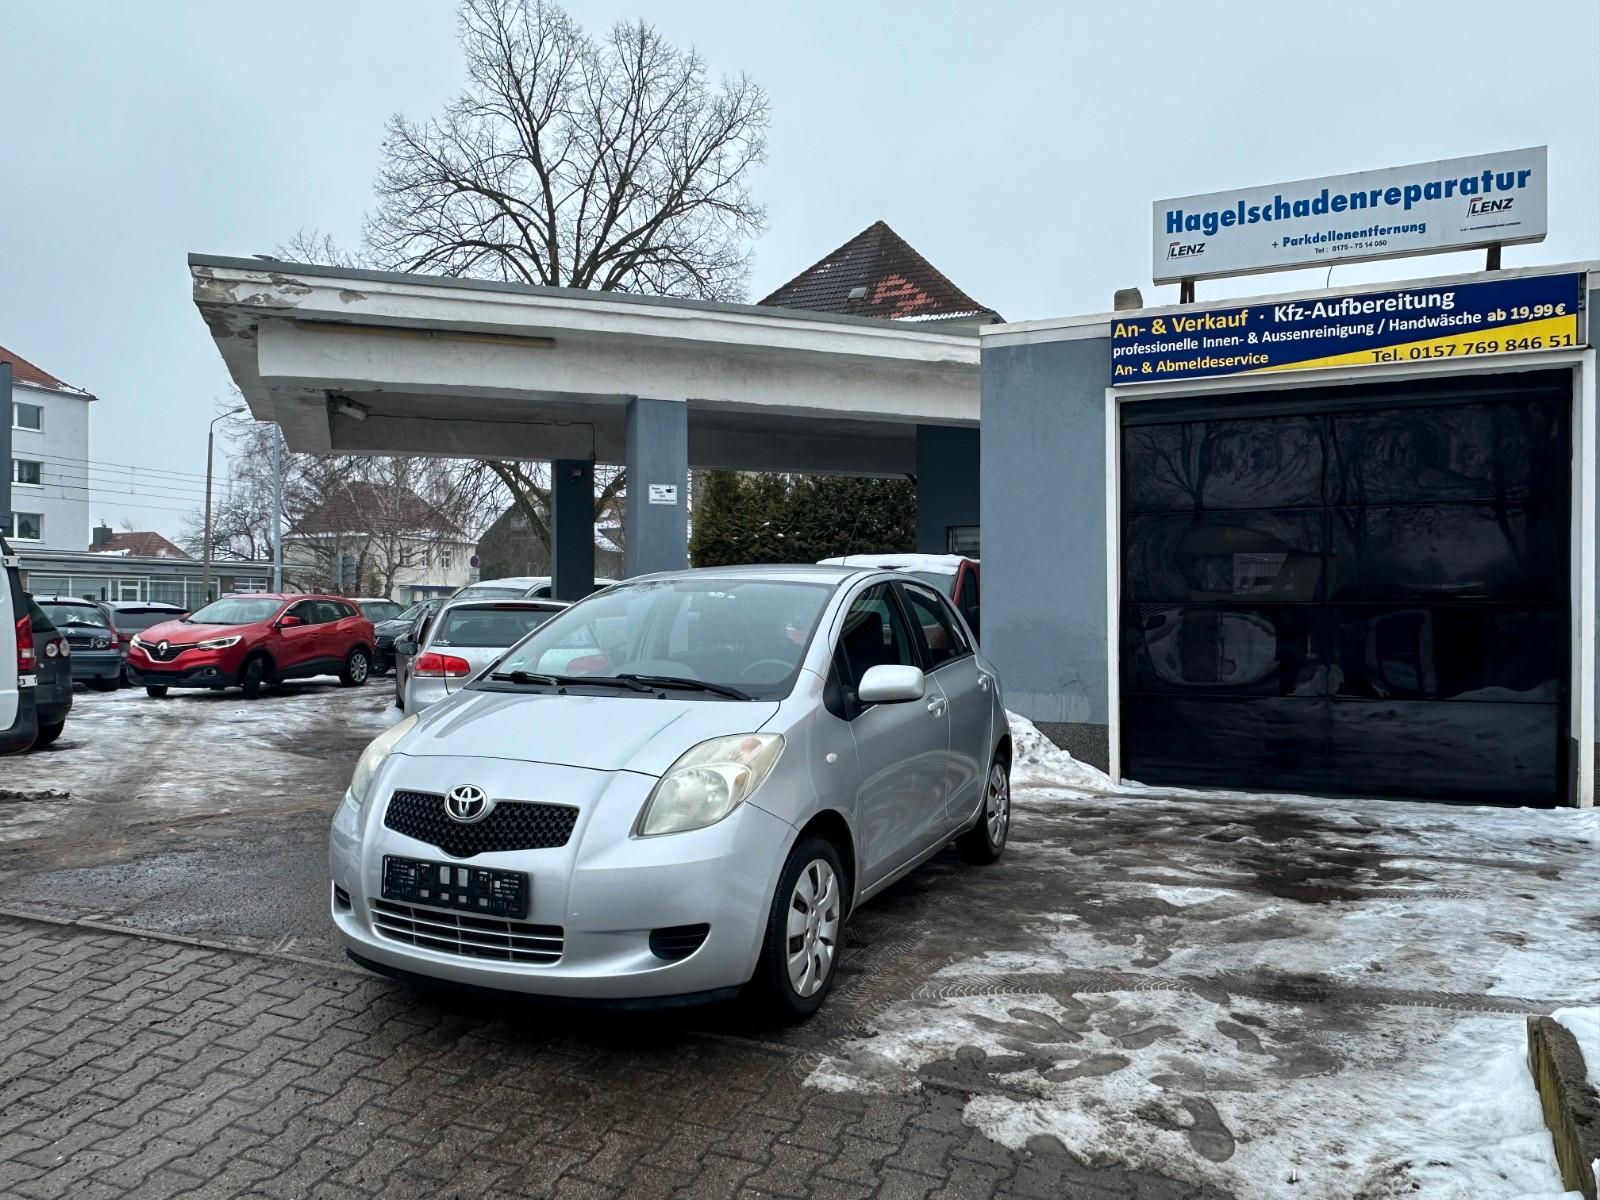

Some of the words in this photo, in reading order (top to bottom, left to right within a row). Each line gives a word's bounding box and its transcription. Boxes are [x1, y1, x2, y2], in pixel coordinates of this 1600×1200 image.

[1166, 167, 1532, 236] Hagelschadenreparatur
[1470, 197, 1514, 214] LENZ
[1282, 222, 1427, 248] Parkdellenentfernung
[1170, 242, 1206, 258] LENZ
[1113, 321, 1146, 339] An-
[1151, 318, 1167, 336] &
[1172, 309, 1249, 333] Verkauf
[1274, 291, 1456, 323] Kfz-Aufbereitung
[1113, 339, 1199, 359] professionelle
[1203, 335, 1244, 349] Innen-
[1247, 332, 1259, 345] &
[1262, 321, 1374, 344] Aussenreinigung
[1389, 311, 1482, 332] Handwäsche
[1487, 307, 1507, 323] ab
[1510, 303, 1553, 322] 19,99
[1372, 348, 1403, 364] Tel.
[1409, 344, 1457, 360] 0157
[1463, 340, 1499, 356] 769
[1505, 336, 1542, 352] 846
[1549, 332, 1574, 348] 51
[1115, 363, 1138, 376] An-
[1141, 360, 1153, 374] &
[1156, 352, 1269, 373] Abmeldeservice
